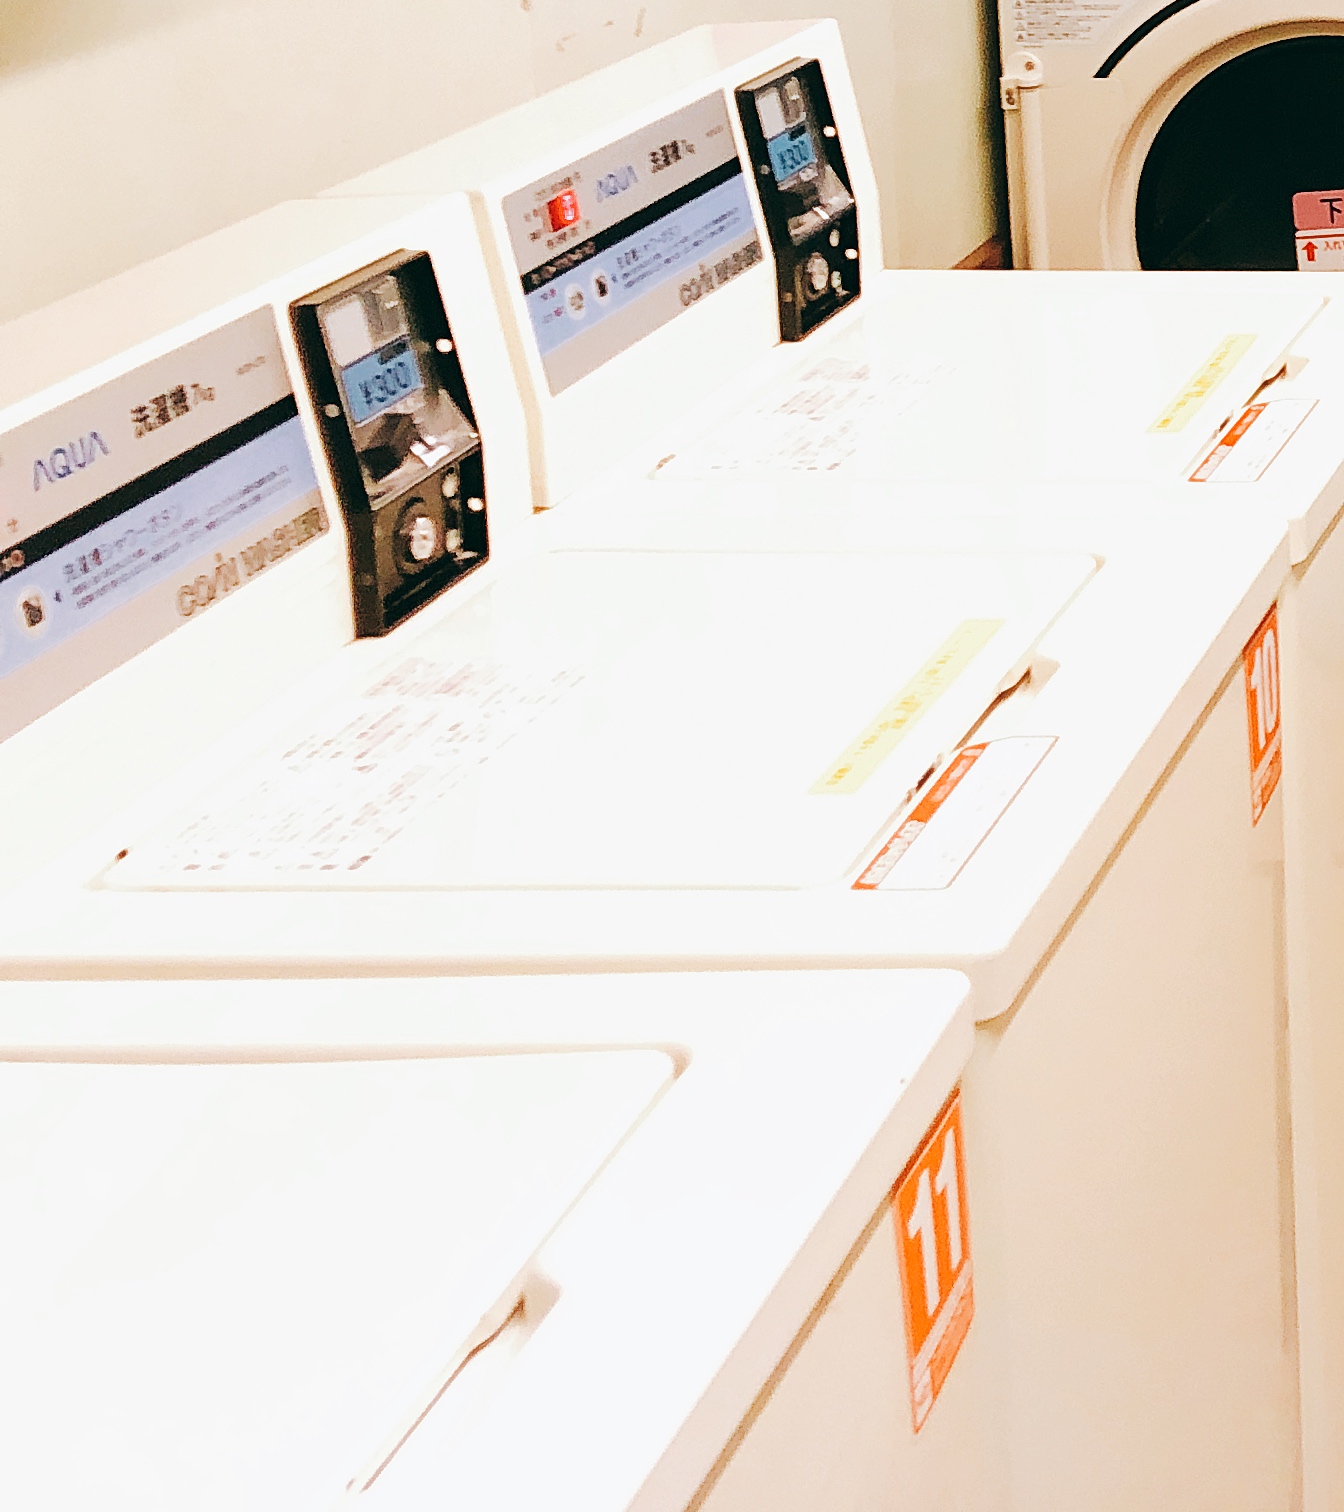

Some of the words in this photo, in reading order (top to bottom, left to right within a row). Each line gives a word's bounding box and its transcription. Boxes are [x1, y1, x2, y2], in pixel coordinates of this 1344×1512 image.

[1319, 197, 1343, 225] 下
[32, 430, 111, 493] AQUA
[130, 383, 191, 439] 洗濯機
[1250, 627, 1279, 751] 10
[906, 1126, 963, 1319] 11
